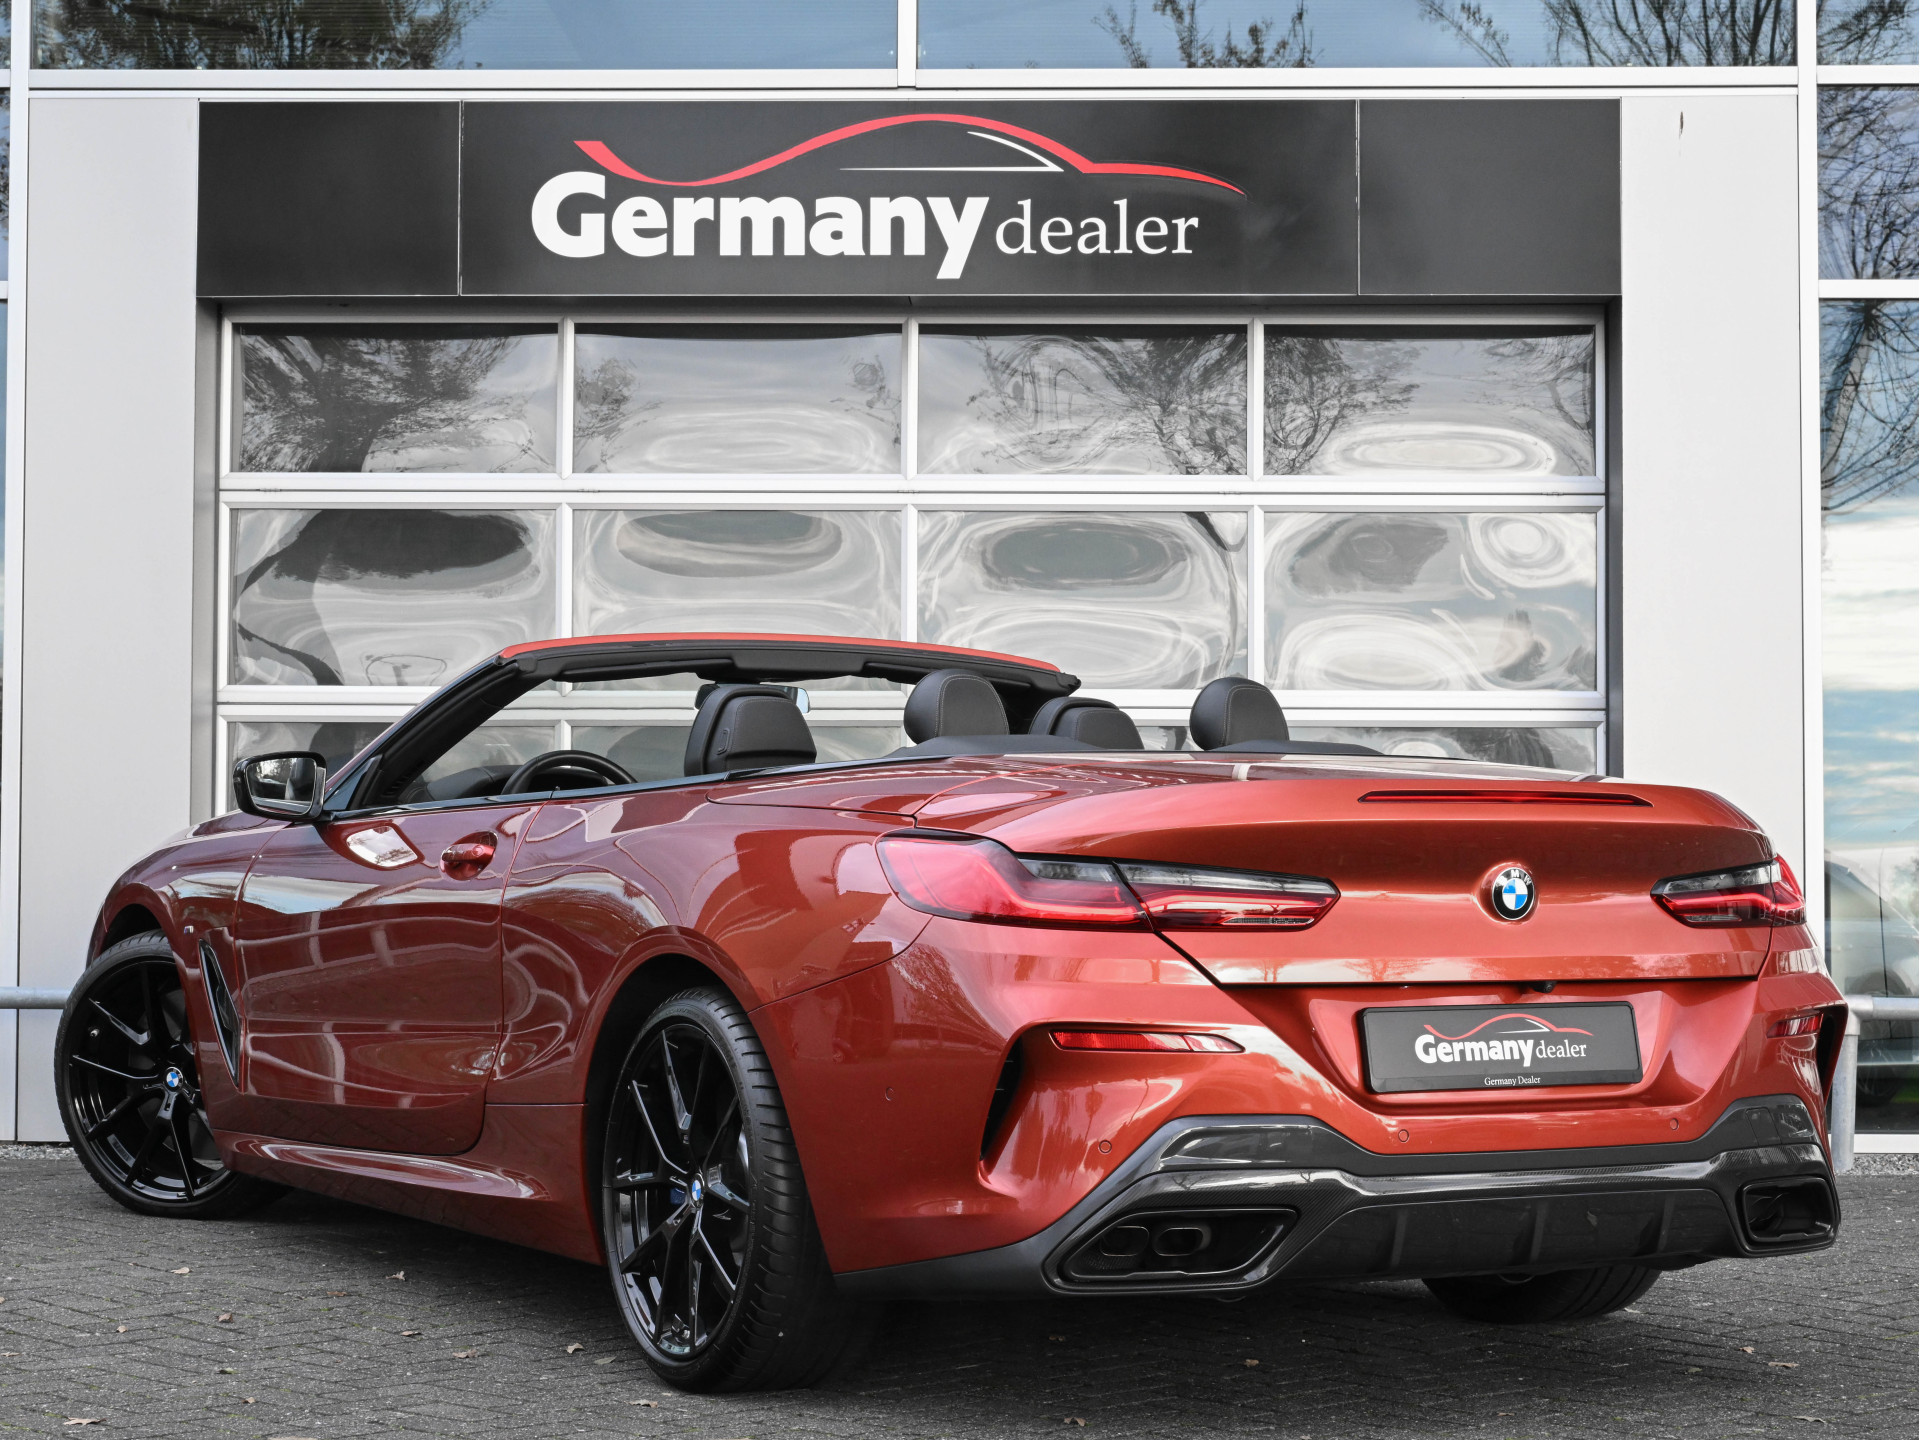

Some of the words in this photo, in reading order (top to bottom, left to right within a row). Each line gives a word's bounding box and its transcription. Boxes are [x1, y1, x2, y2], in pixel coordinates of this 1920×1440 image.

[532, 171, 989, 279] Germany
[996, 199, 1198, 255] dealer
[1415, 1034, 1534, 1067] Germany
[1536, 1039, 1587, 1059] dealer
[1484, 1077, 1517, 1086] Germany
[1518, 1075, 1541, 1085] Dealer
